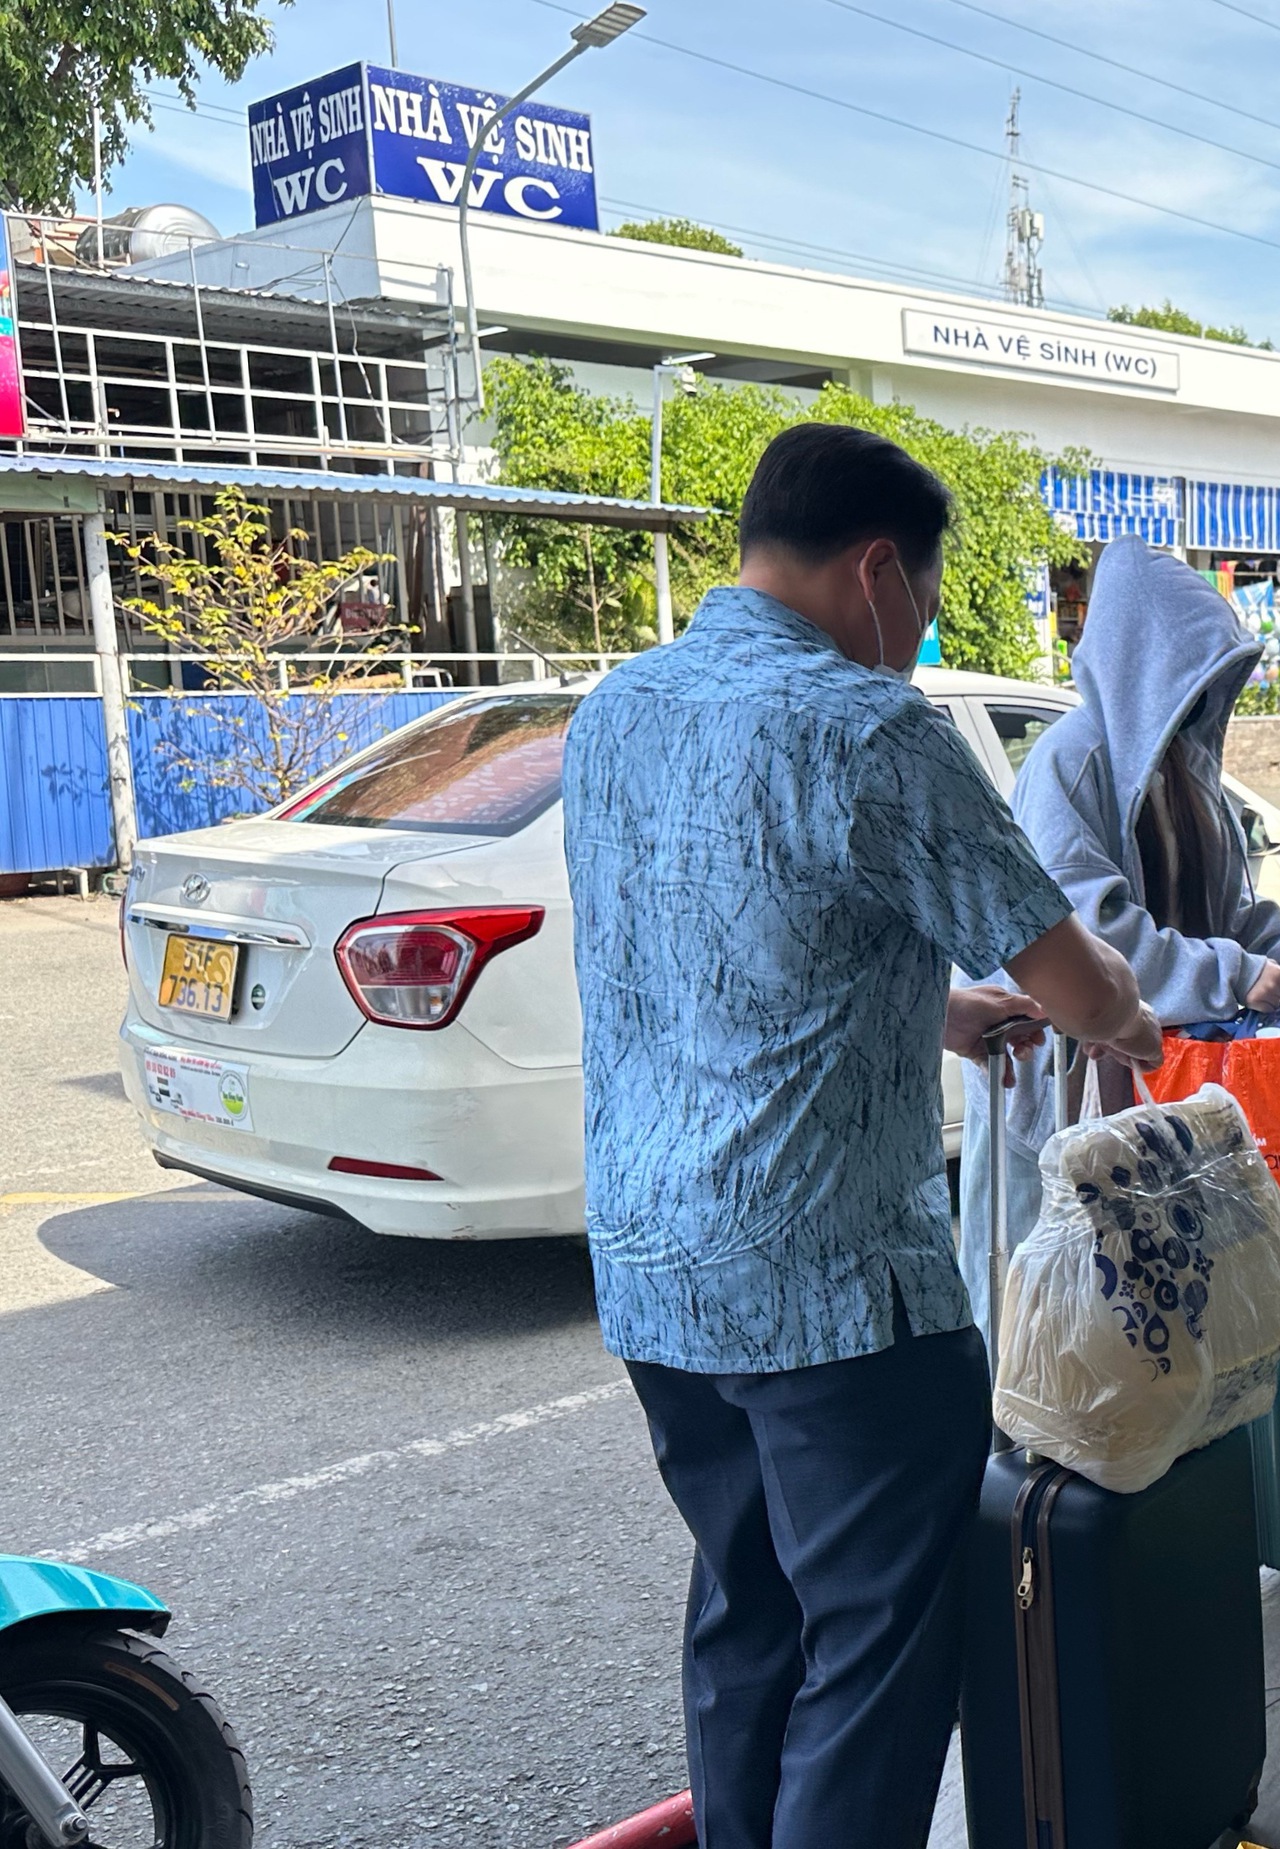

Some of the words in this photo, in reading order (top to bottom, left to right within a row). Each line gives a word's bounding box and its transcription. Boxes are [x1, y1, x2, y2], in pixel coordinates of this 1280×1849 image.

[251, 101, 290, 168] NHÀ
[290, 92, 315, 161] VỆ
[318, 85, 364, 147] SINH
[370, 83, 453, 145] NHÀ
[456, 97, 506, 165] VỆ
[514, 116, 594, 174] SINH
[273, 157, 349, 215] WC
[416, 156, 564, 221] WC
[933, 325, 990, 351] NHÀ
[998, 334, 1031, 361] VỆ
[1105, 351, 1158, 379] (WC)
[168, 974, 223, 1013] 736.13
